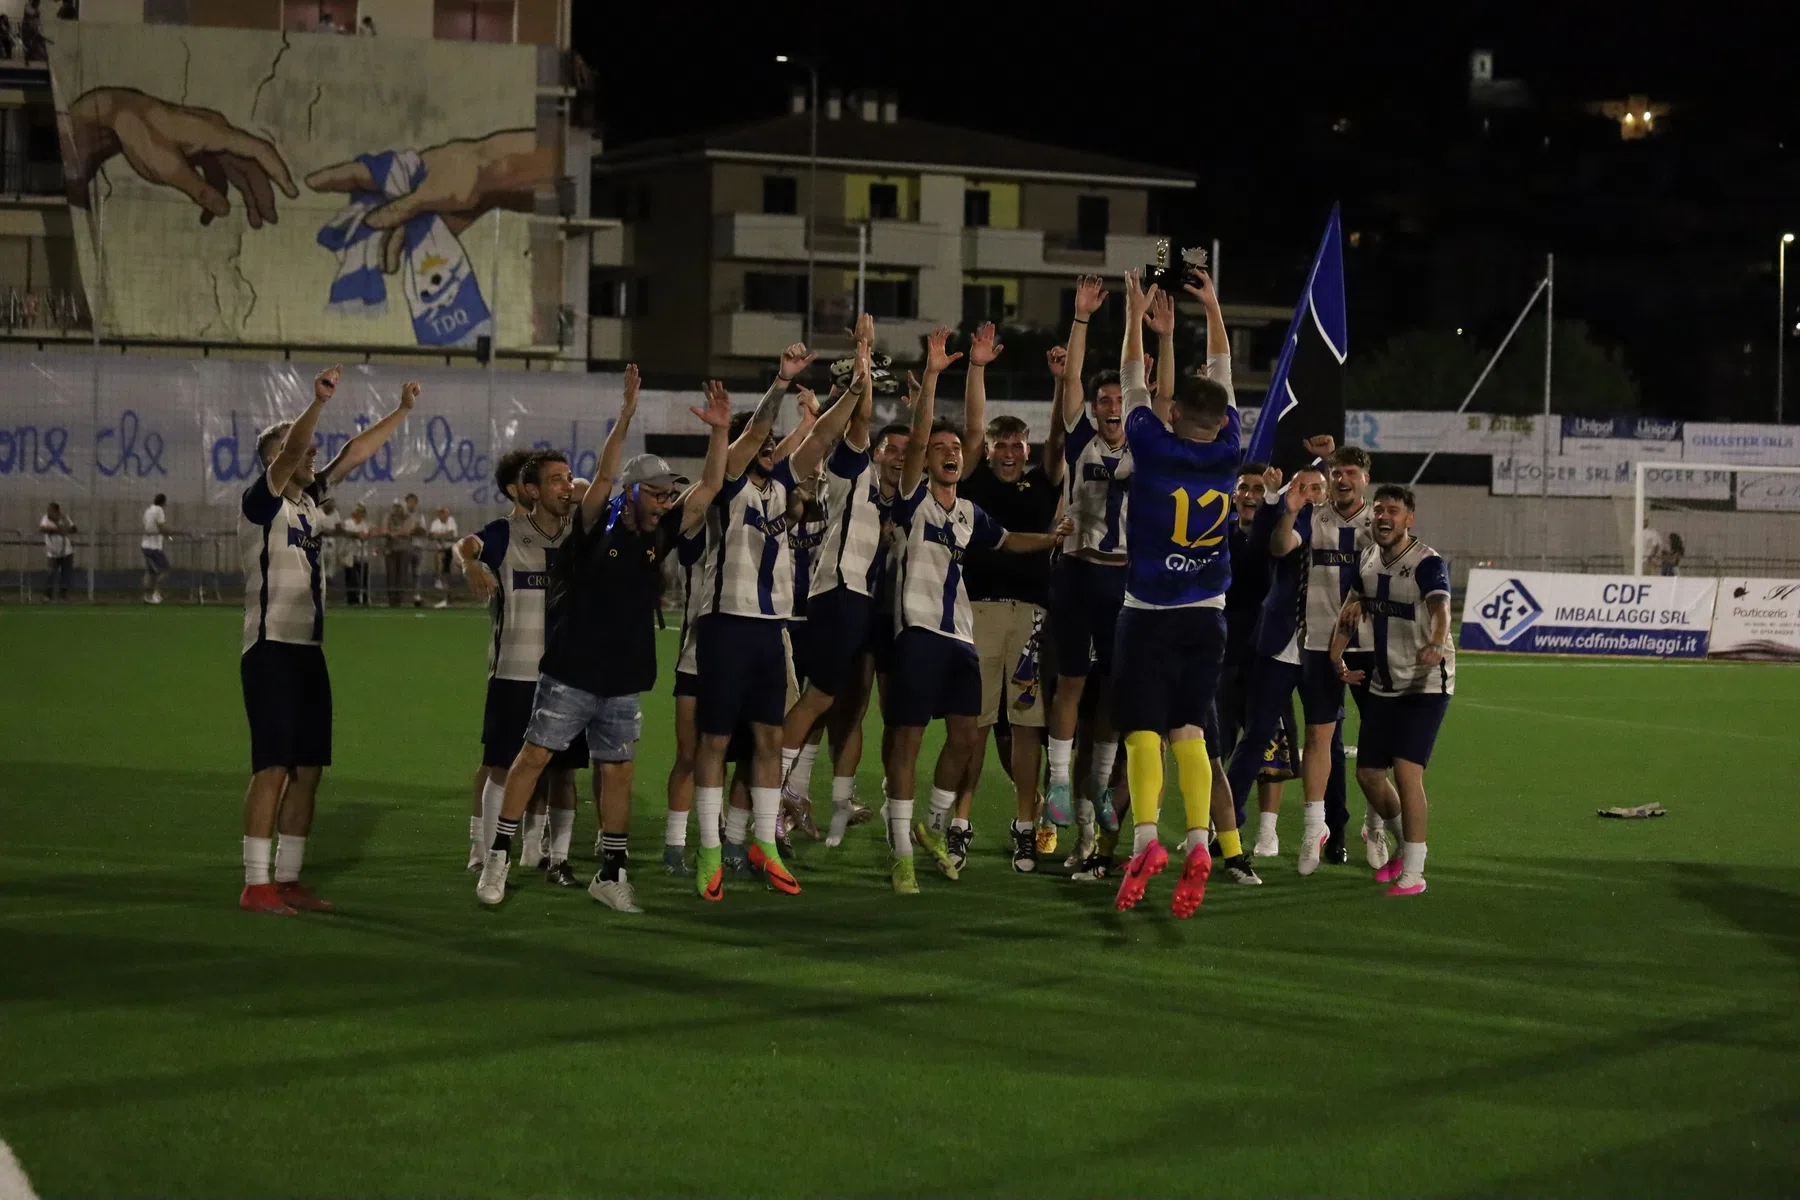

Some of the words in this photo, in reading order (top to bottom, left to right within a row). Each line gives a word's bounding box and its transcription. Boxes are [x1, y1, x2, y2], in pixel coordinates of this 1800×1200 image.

[1575, 417, 1614, 437] Unipol
[1637, 418, 1677, 440] Unipol
[96, 409, 168, 477] che
[1586, 466, 1610, 481] SRL
[1645, 468, 1695, 482] OGER
[1168, 486, 1230, 549] 12
[1602, 583, 1652, 605] CDF
[1554, 606, 1656, 625] IMBALLAGGI
[1660, 610, 1691, 625] SRL
[1732, 606, 1788, 619] Pasticceria
[1534, 631, 1698, 655] www.cdfimballaggi.it
